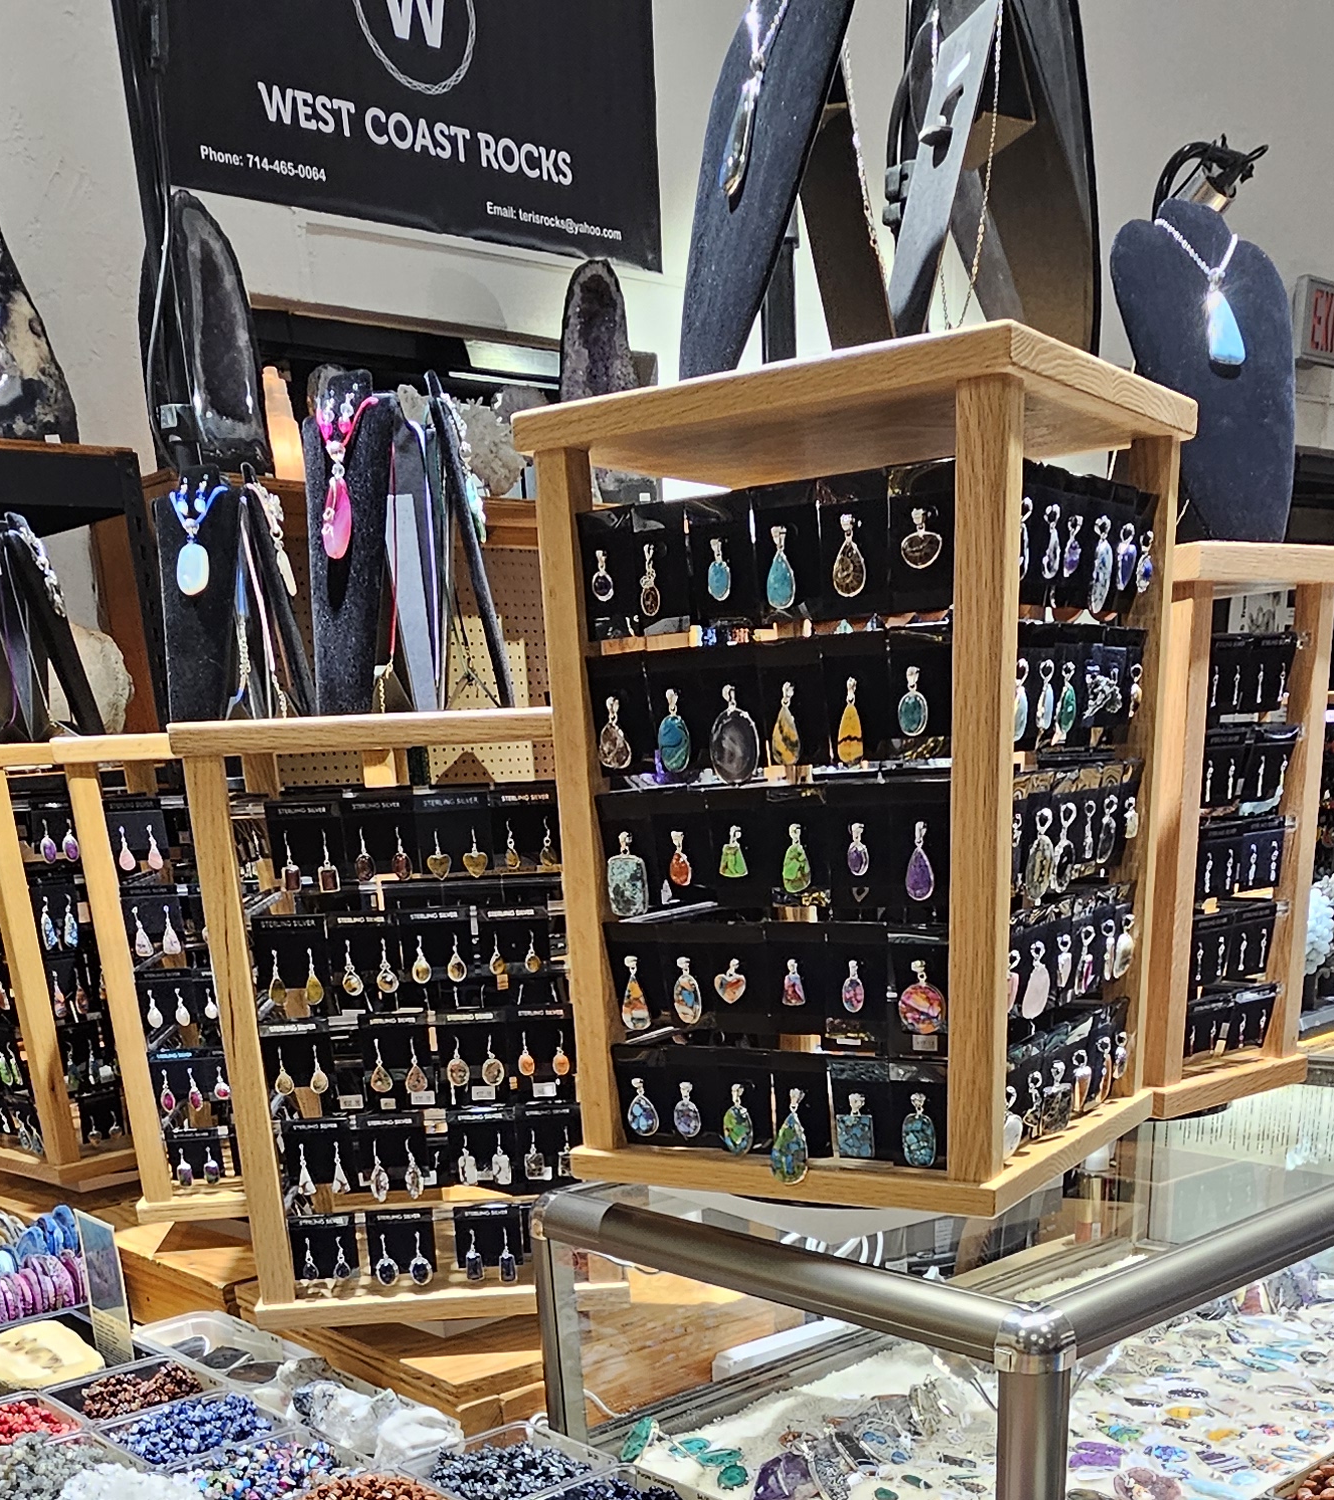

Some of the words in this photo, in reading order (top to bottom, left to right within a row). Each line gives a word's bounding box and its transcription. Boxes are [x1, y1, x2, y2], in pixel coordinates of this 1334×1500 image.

[257, 81, 356, 138] WEST
[364, 106, 470, 163] COAST
[476, 132, 573, 186] ROCKS
[199, 144, 244, 167] Phone:
[246, 153, 327, 182] 714-465-0064
[486, 201, 517, 220] Email:
[518, 208, 622, 241] terisrocks@yahoo.com
[423, 798, 455, 807] STERLING
[456, 796, 479, 805] SILVER
[501, 795, 529, 803] STERLING
[277, 807, 306, 815] STERLING
[307, 806, 327, 814] SILVER
[260, 921, 291, 929] STERLING
[292, 920, 317, 928] SILVER
